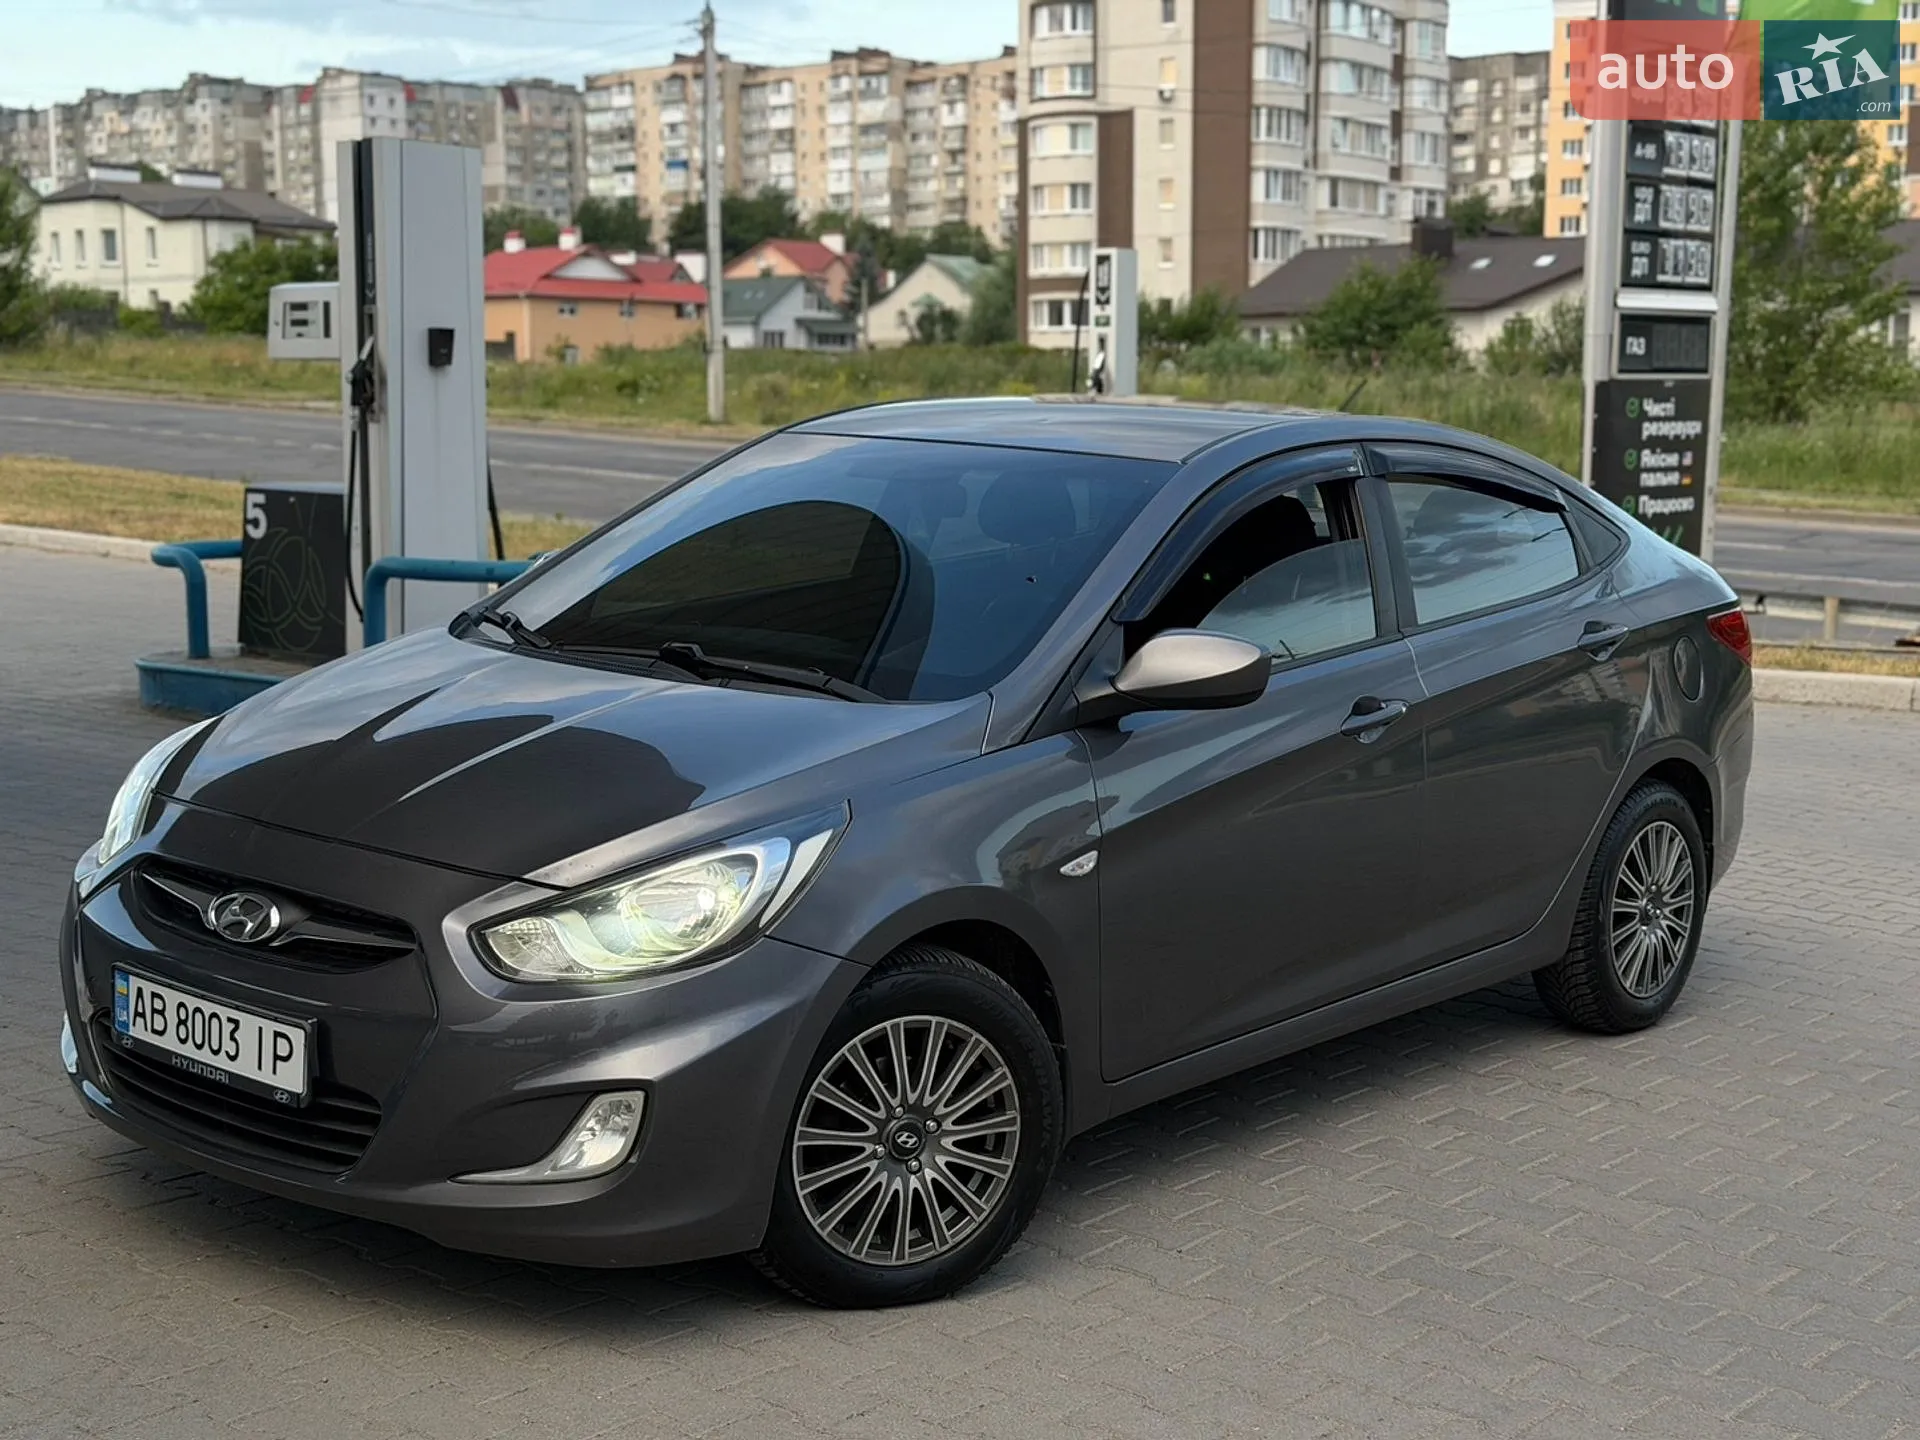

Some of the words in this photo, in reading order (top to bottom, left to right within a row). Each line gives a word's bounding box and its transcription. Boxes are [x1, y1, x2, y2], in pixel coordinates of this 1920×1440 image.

[1642, 397, 1676, 417] Чисті
[245, 493, 267, 539] 5
[132, 986, 168, 1036] AB
[176, 1001, 241, 1062] 8003
[257, 1025, 294, 1076] IP
[171, 1054, 230, 1085] HYUNDAI
